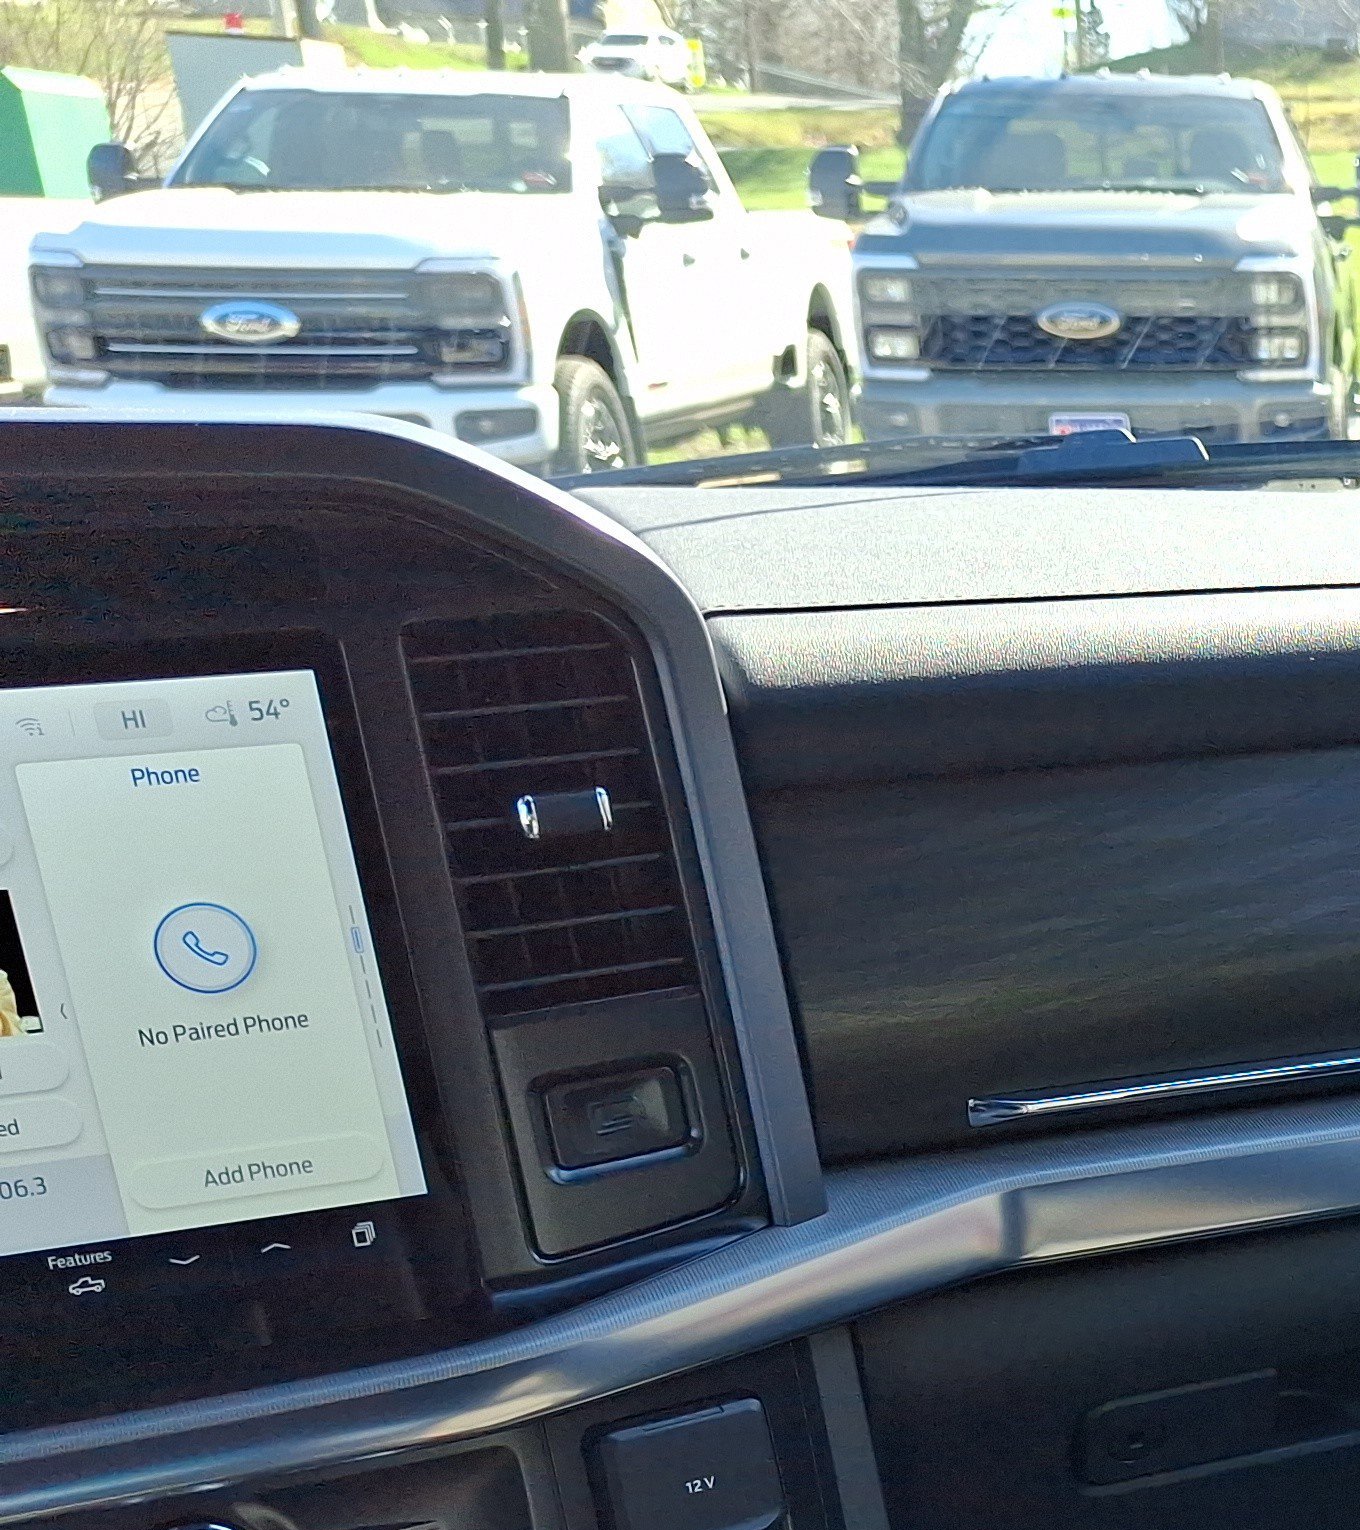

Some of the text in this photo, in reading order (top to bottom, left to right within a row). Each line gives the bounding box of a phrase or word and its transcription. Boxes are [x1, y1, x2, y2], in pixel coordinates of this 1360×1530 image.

[121, 710, 146, 730] HI
[248, 698, 290, 722] 54°
[131, 764, 201, 788] Phone
[138, 1010, 310, 1048] No Paired Phone
[204, 1156, 315, 1189] Add Phone
[48, 1248, 113, 1271] Features
[685, 1479, 703, 1494] 12
